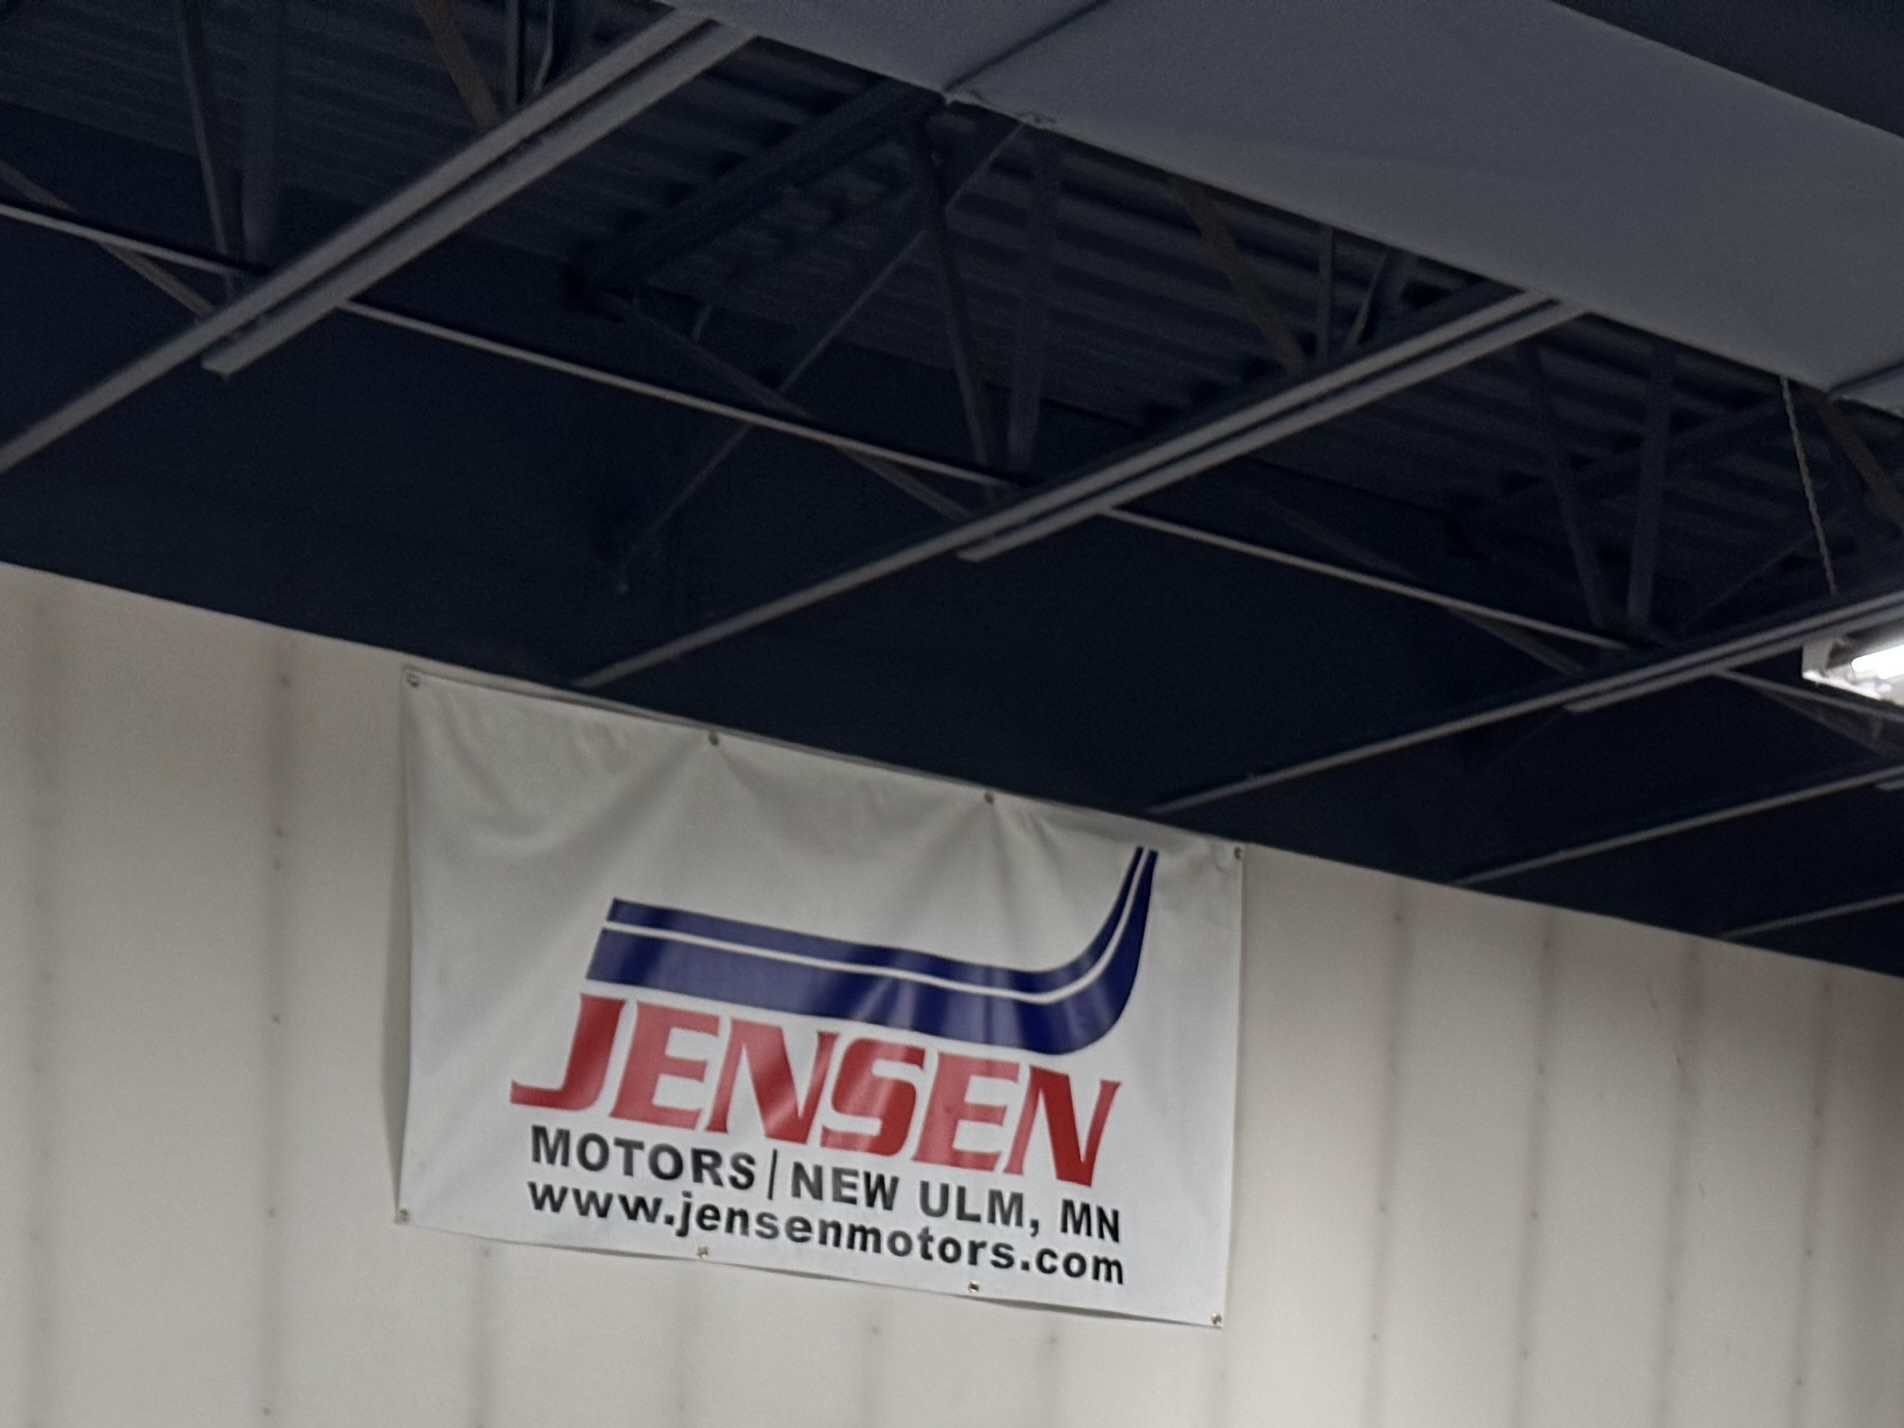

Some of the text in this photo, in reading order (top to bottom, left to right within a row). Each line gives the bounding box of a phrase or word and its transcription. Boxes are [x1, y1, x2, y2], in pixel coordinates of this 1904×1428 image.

[510, 993, 1122, 1188] JENSEN
[528, 1181, 1125, 1286] www.jensenmotors.com
[530, 1125, 1121, 1243] MOTORS NEW ULM, MN
